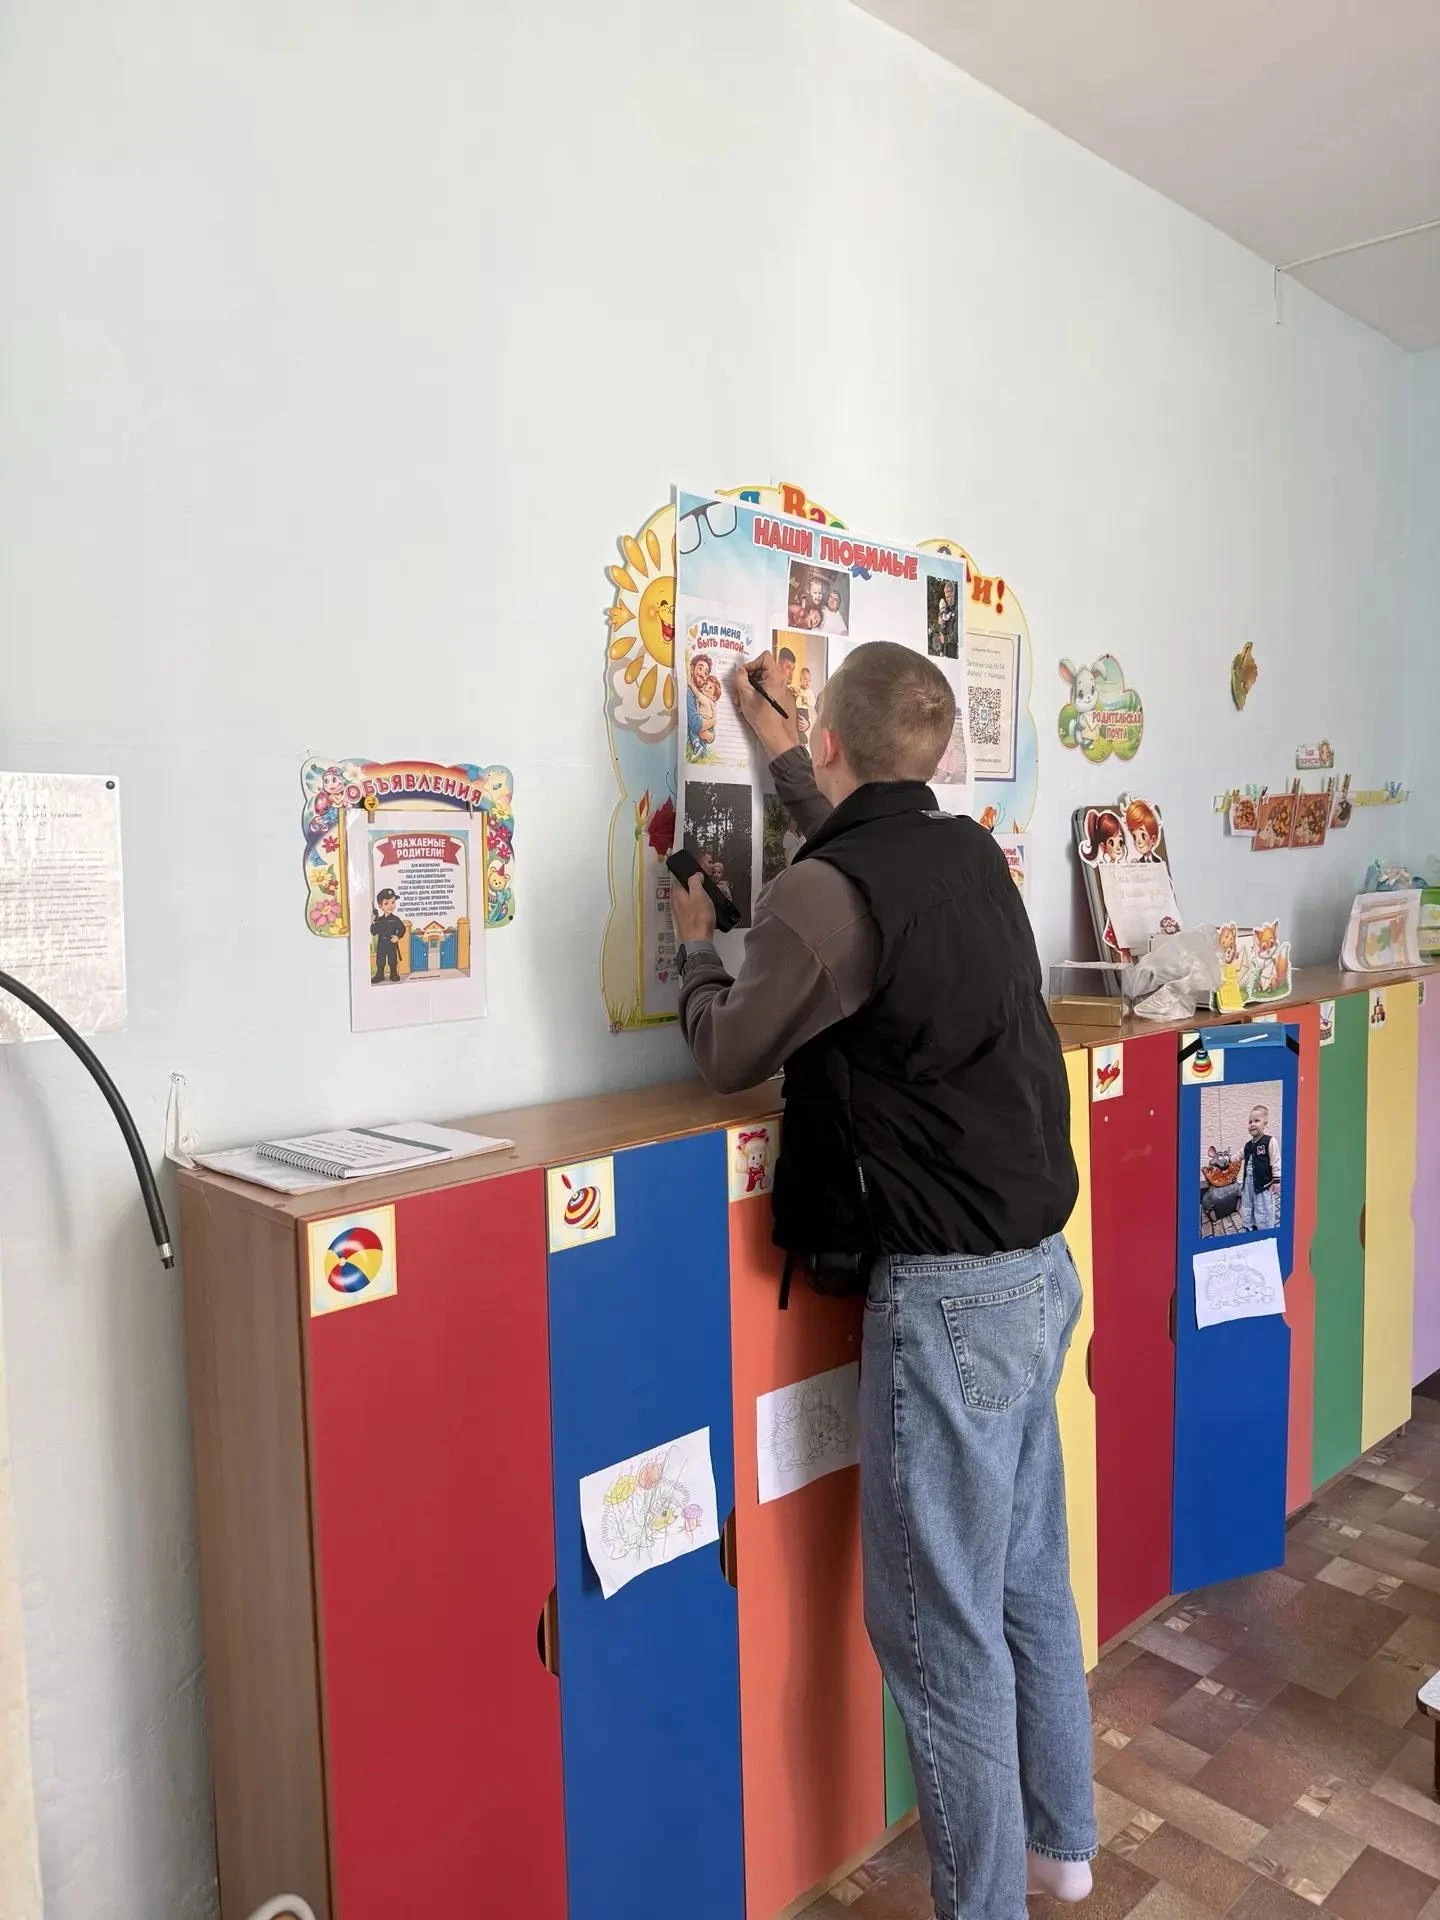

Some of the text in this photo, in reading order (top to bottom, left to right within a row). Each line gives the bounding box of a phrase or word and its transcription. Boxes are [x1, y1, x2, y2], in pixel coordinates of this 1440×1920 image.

[755, 518, 918, 580] НАШИ ЛЮБИМЫЕ
[701, 622, 741, 640] Для меня
[1092, 711, 1142, 724] РОДИТЕЛЬСКАЯ
[1106, 727, 1128, 739] ПОЧТА
[345, 774, 482, 806] ОБЪЯВЛЕНИЯ
[391, 838, 446, 849] УВАЖАЕМЫЕ
[396, 848, 445, 859] РОДИТЕЛИ!
